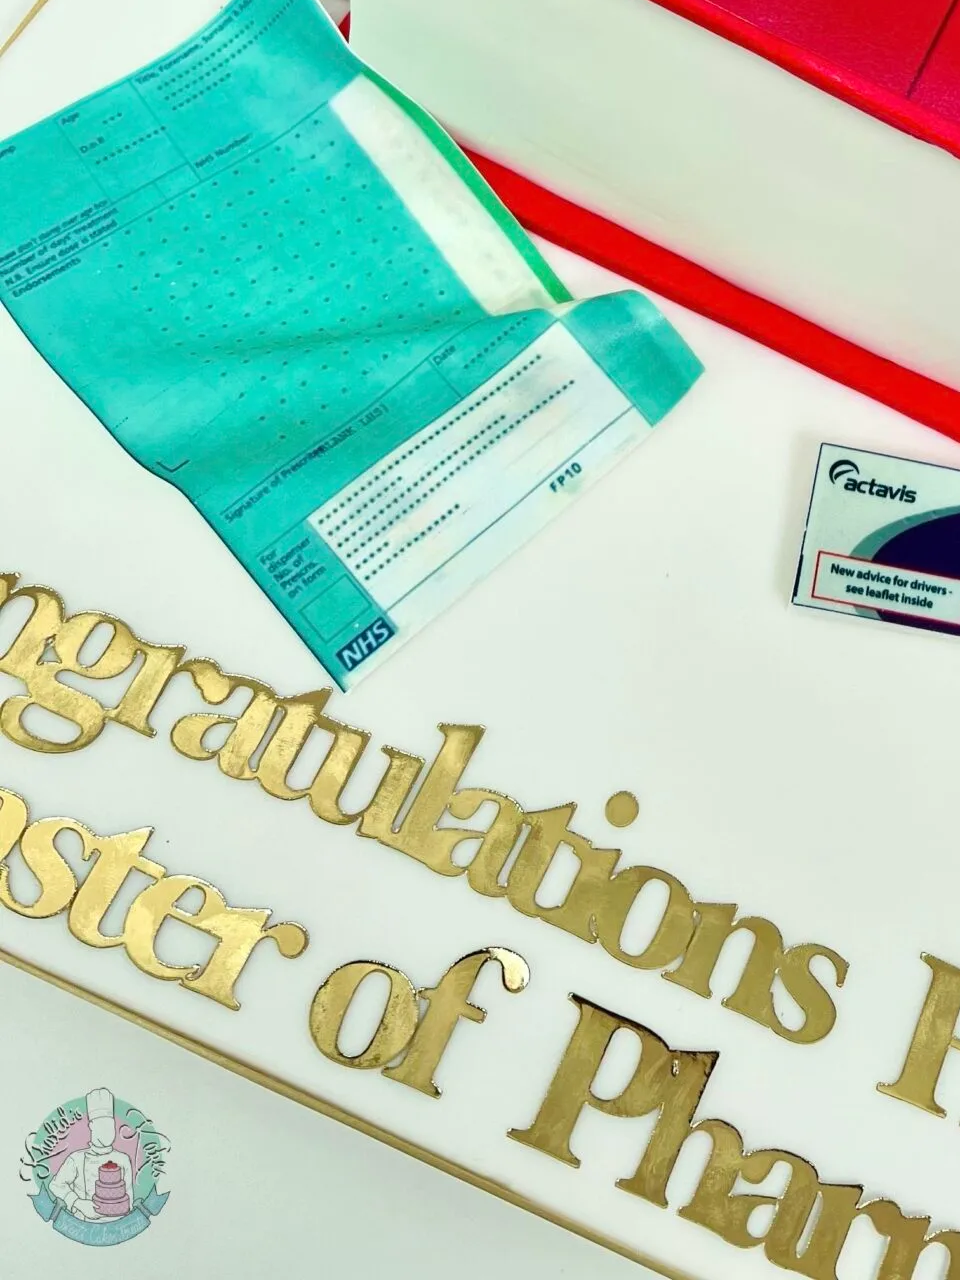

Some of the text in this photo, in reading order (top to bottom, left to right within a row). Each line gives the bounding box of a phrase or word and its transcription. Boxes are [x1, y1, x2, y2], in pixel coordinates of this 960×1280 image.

[432, 344, 456, 367] Date
[549, 461, 582, 493] FP10
[843, 476, 917, 504] actavis
[223, 486, 272, 525] Signature
[260, 548, 277, 565] For
[830, 563, 855, 578] New
[856, 569, 891, 585] advice
[892, 574, 909, 588] for
[910, 578, 947, 596] drivers
[845, 584, 933, 609] see leaflet inside
[341, 620, 389, 669] NHS
[0, 572, 849, 1045] ngratulations
[0, 787, 309, 1012] ster
[308, 946, 530, 1100] of
